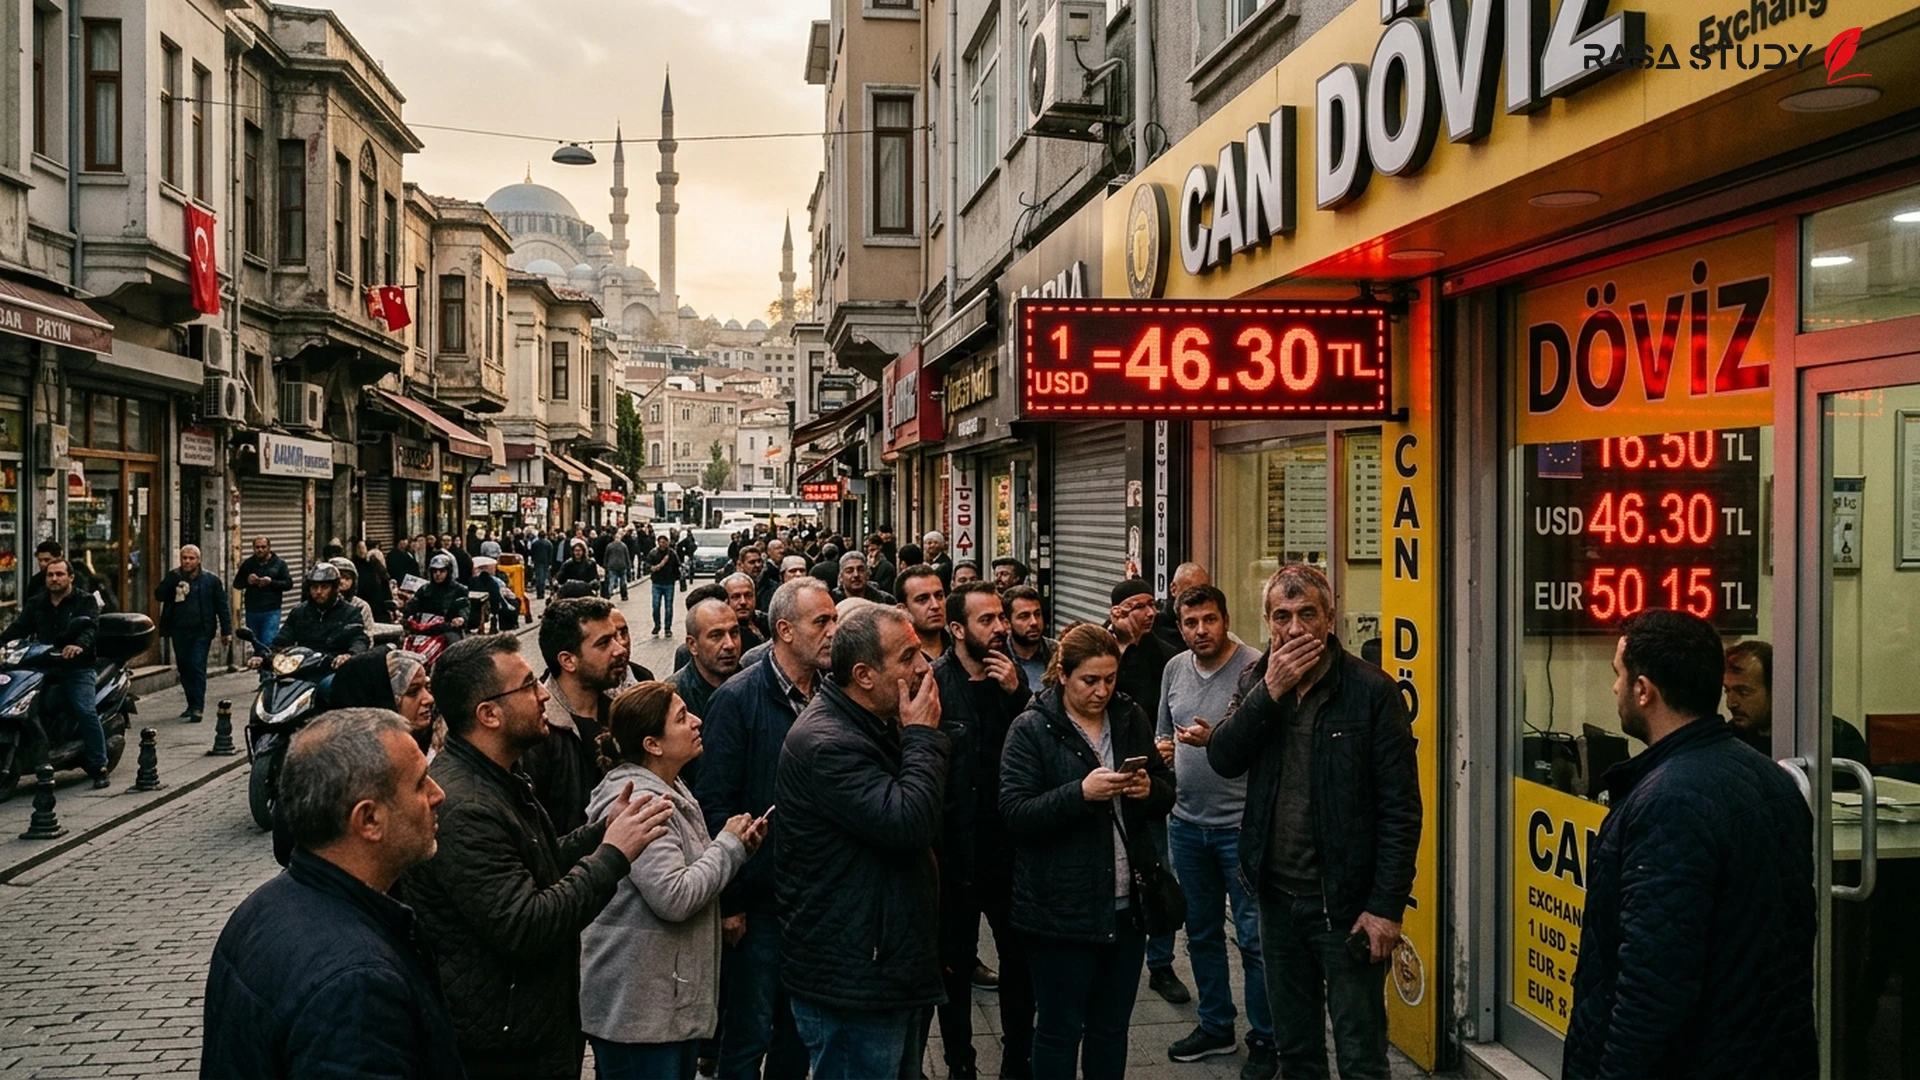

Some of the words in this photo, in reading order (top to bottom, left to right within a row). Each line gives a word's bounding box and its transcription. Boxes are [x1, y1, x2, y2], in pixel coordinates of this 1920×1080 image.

[1180, 105, 1296, 275] CAN
[1051, 325, 1067, 359] 1
[1528, 258, 1771, 416] DÖVİZ
[1327, 343, 1376, 376] TL
[1035, 372, 1088, 394] USD
[1722, 433, 1752, 461] TL
[1393, 434, 1420, 580] CAN
[1535, 507, 1583, 535] USD
[1589, 492, 1713, 543] 46.30
[1721, 508, 1751, 535] TL
[1535, 582, 1583, 610] EUR
[1721, 582, 1751, 609] TL
[1528, 918, 1534, 937] 1
[1539, 922, 1566, 952] USD
[1528, 948, 1555, 980] EUR
[1528, 978, 1554, 1011] EUR
